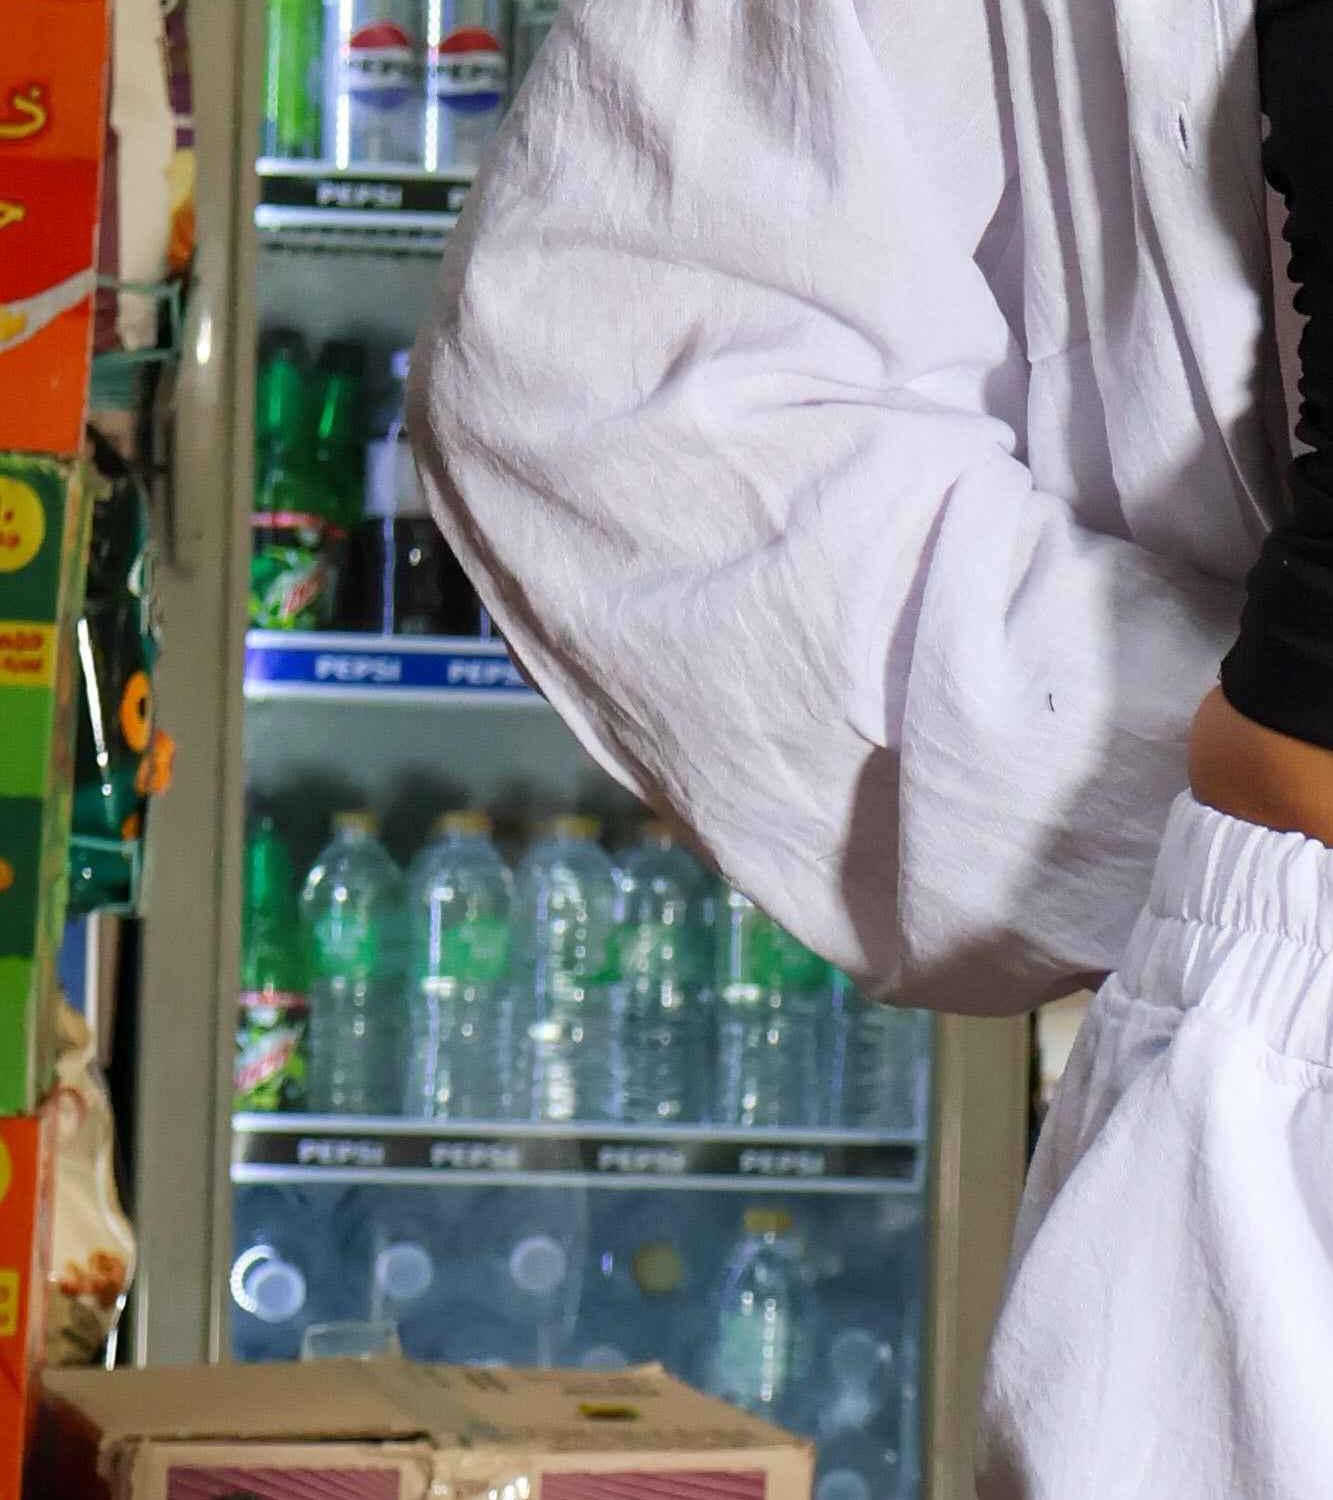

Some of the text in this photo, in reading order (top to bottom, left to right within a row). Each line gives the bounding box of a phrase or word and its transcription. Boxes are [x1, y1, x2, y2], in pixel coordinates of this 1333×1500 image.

[317, 181, 402, 208] PEPSI
[315, 654, 401, 683] PEPSI
[298, 1139, 825, 1178] PEPSI PEPSI PEPSI PEPSI
